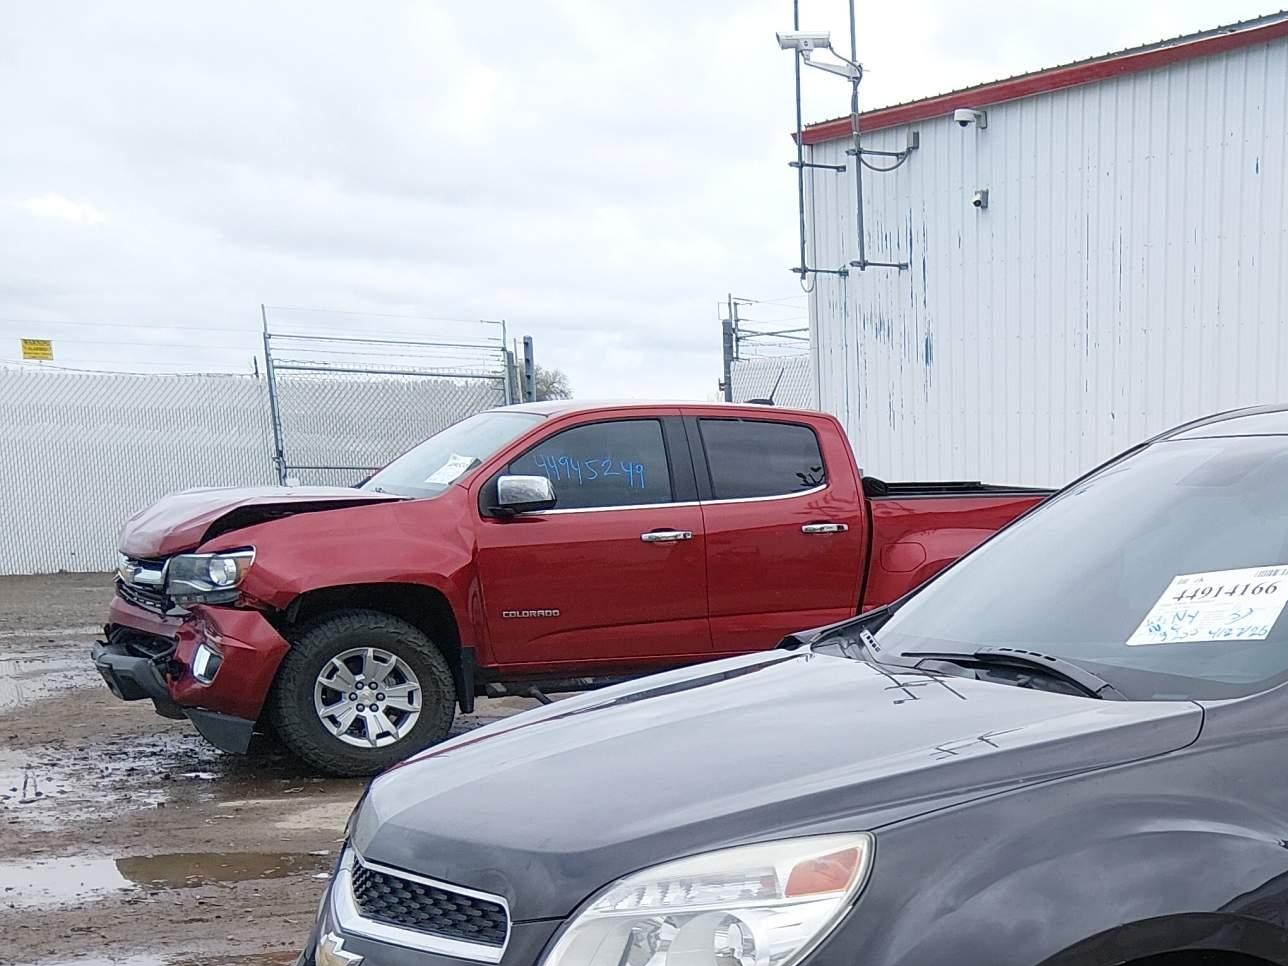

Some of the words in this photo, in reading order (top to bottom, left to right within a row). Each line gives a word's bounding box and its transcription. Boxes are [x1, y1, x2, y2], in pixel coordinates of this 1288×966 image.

[534, 455, 645, 488] 44945249
[1173, 581, 1279, 601] 44914166
[502, 609, 560, 618] COLORADO
